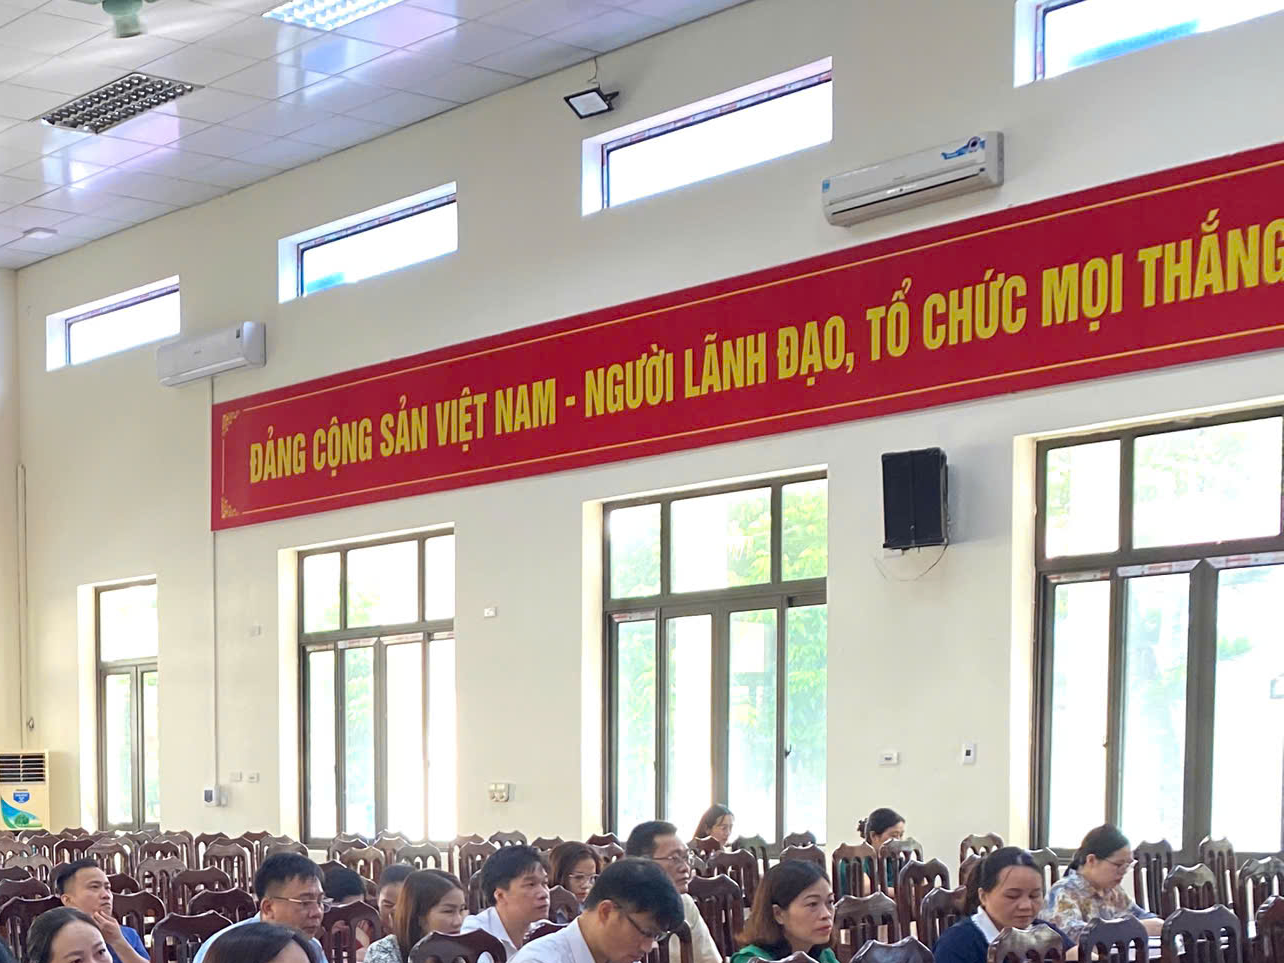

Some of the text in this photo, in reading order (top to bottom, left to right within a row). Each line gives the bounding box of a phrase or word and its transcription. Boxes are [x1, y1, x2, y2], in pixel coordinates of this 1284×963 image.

[249, 425, 306, 483] ĐẢNG
[313, 416, 373, 477] CỘNG
[379, 394, 428, 457] SẢN
[435, 386, 488, 452] VIỆT
[495, 378, 556, 435] NAM
[585, 343, 674, 417] NGƯỜI
[684, 333, 767, 399] LÃNH
[776, 315, 854, 385] ĐẠO,
[866, 277, 913, 361] TỔ
[923, 269, 1028, 350] CHỨC
[1041, 253, 1123, 332] MỌI
[1137, 208, 1284, 308] THẮNG
